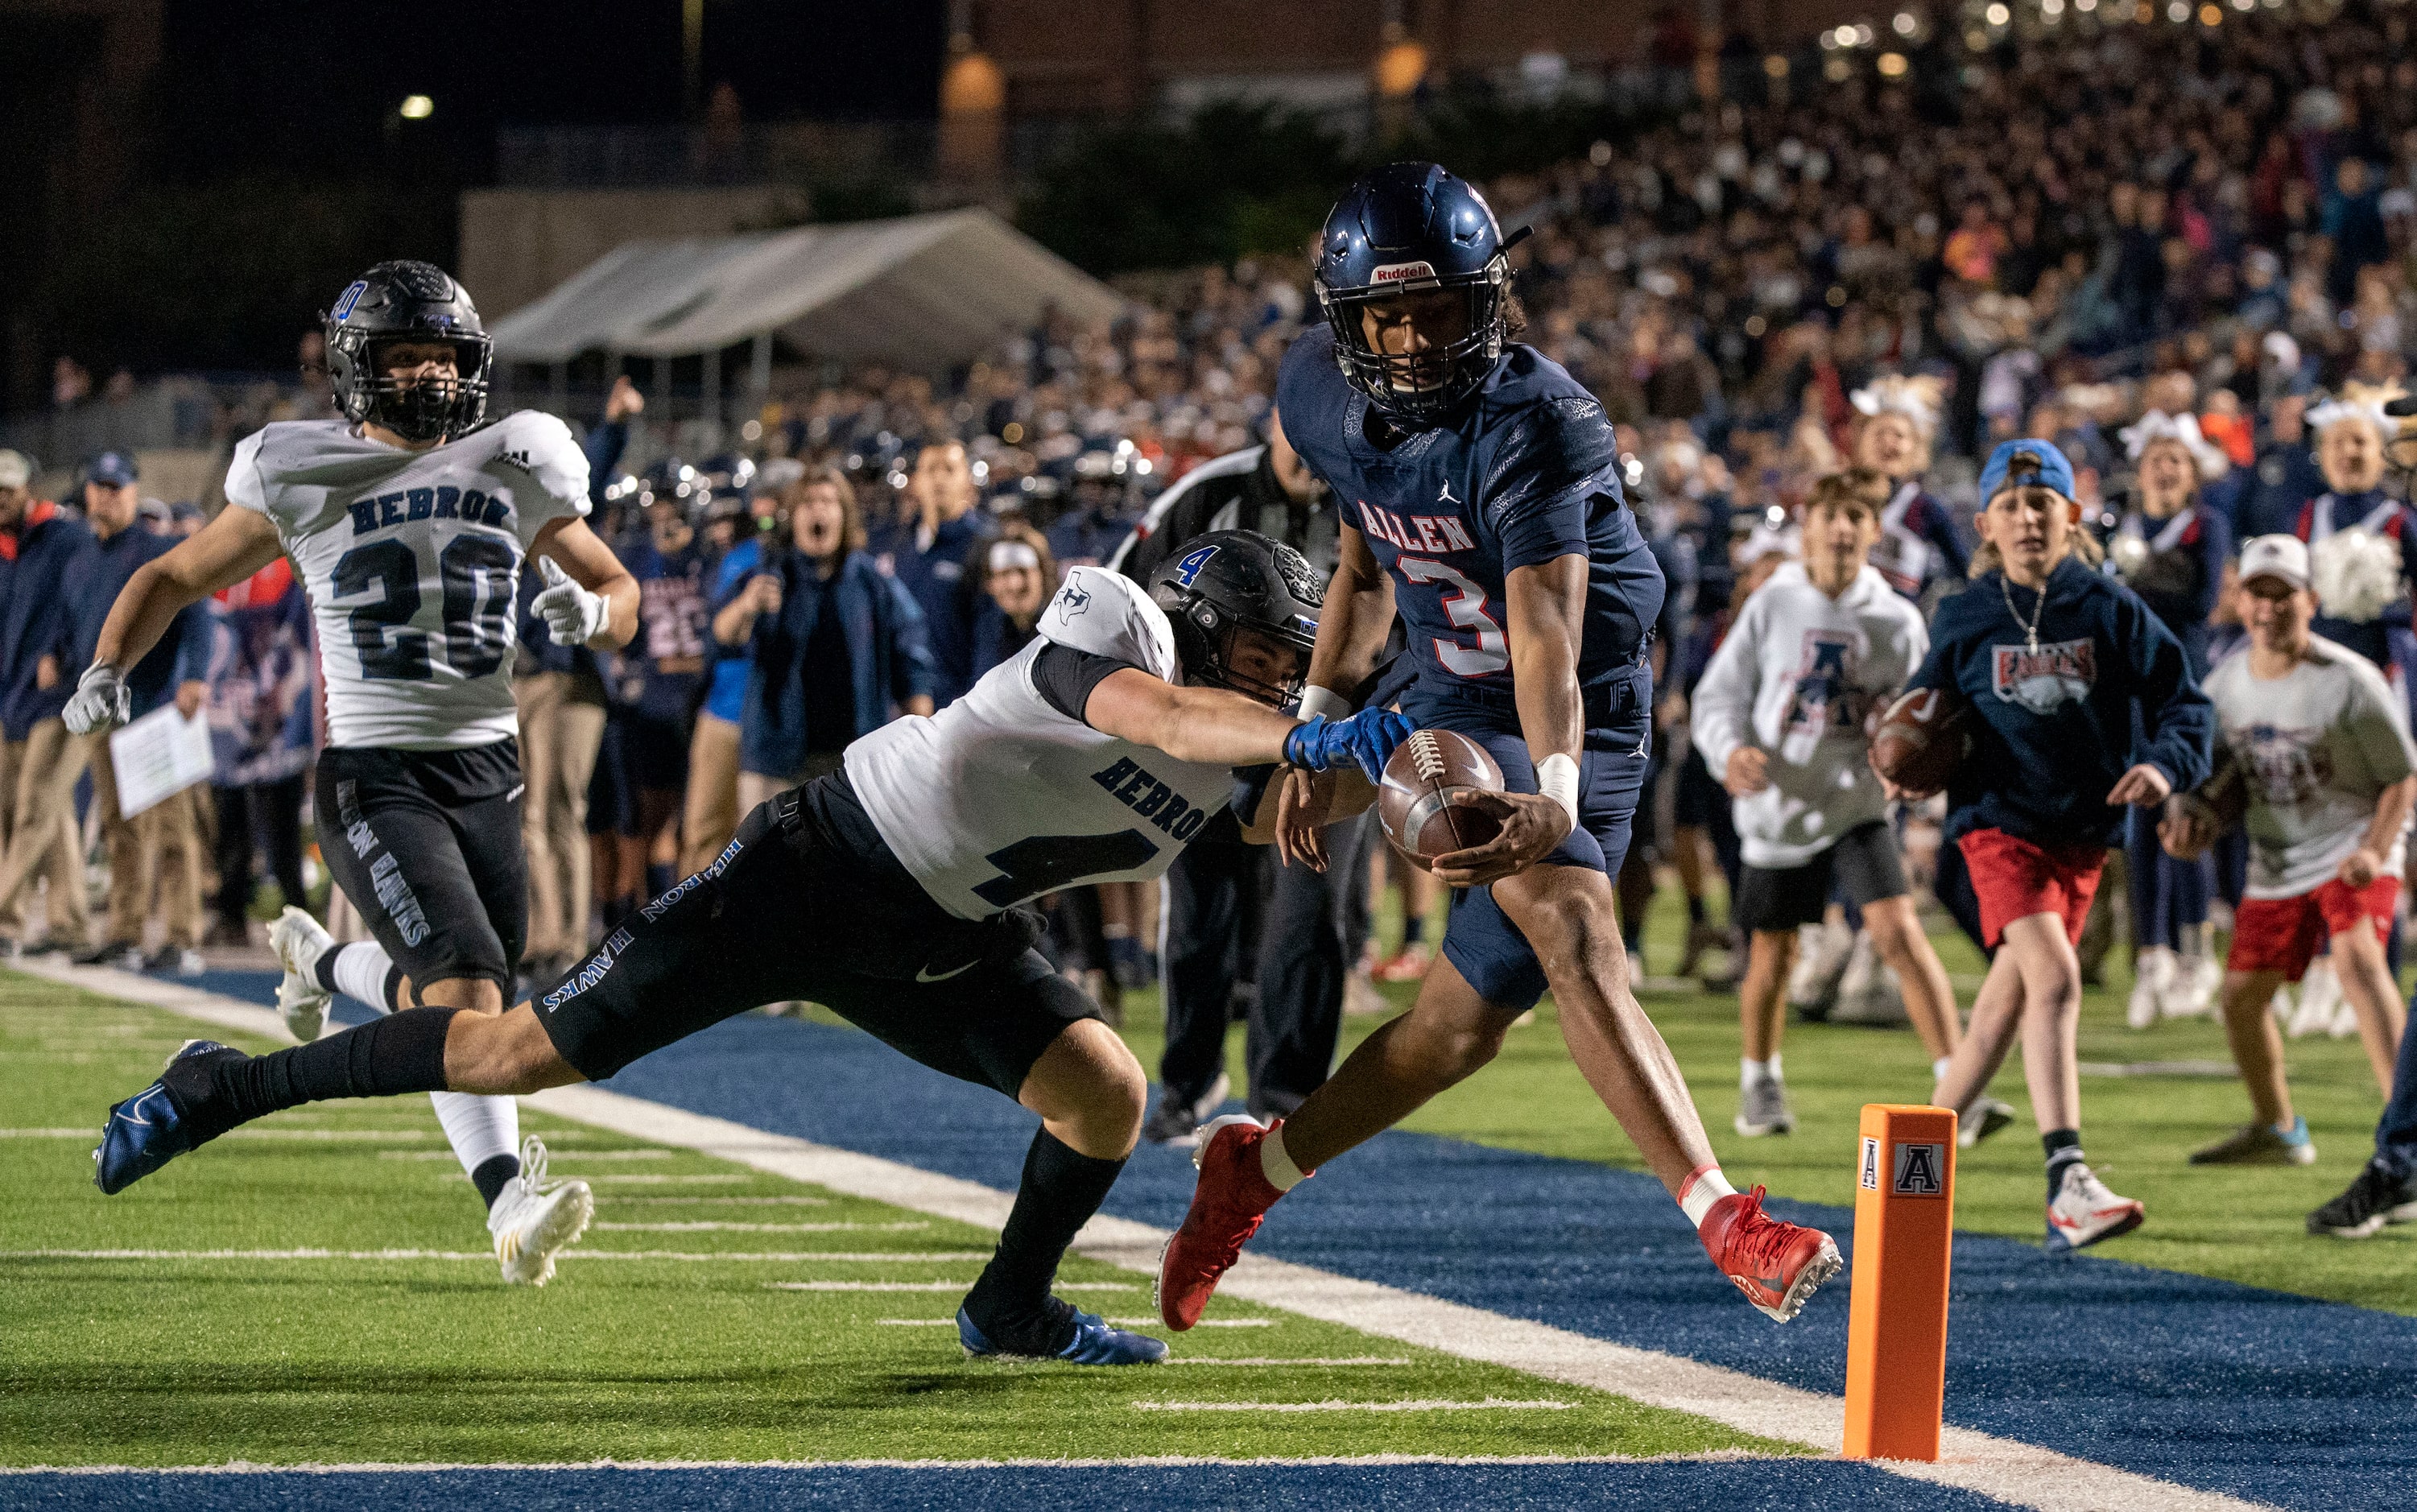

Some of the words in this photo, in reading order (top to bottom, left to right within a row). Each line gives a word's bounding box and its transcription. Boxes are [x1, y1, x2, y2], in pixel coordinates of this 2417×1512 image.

[1378, 266, 1427, 280] Riddell
[347, 485, 510, 535] HEBRON
[1357, 500, 1477, 553] ALLEN
[1175, 544, 1221, 589] 4
[330, 534, 516, 679] 20
[1396, 554, 1511, 679] 3
[1090, 755, 1205, 844] HEBRO
[370, 851, 431, 948] HAWKS
[640, 837, 744, 923] HERON
[543, 927, 635, 1013] HAWKS
[1861, 1139, 1877, 1190] A
[1895, 1145, 1940, 1193] A
